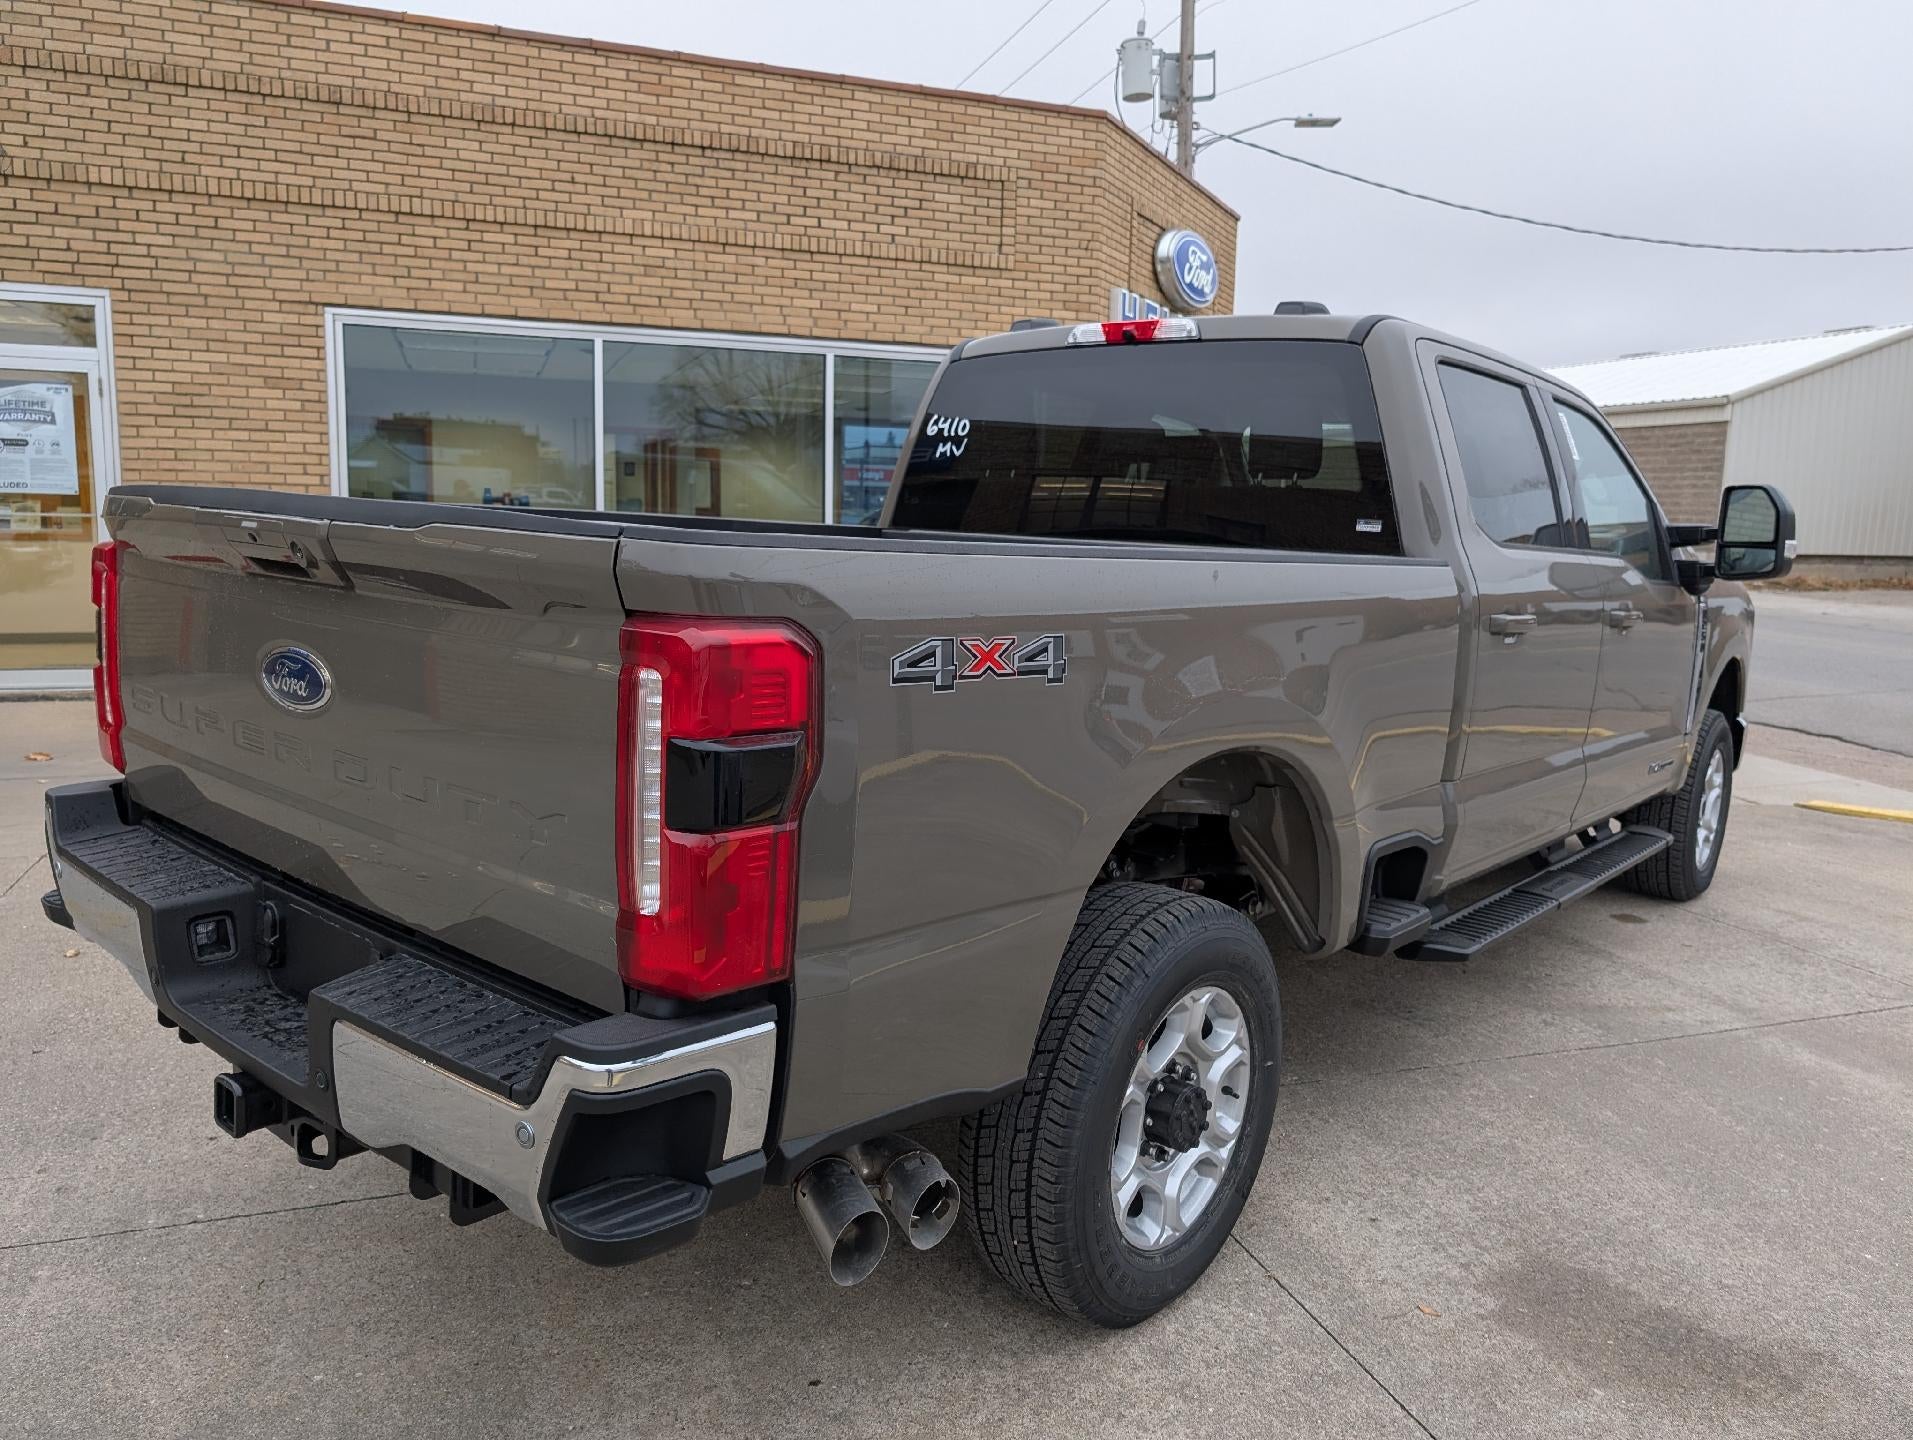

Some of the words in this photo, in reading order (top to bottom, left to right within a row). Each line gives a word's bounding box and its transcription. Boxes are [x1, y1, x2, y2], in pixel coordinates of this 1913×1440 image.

[1183, 245, 1214, 294] Ford
[926, 413, 970, 437] 6410
[271, 658, 310, 697] Ford
[131, 685, 312, 773] SUPER
[333, 748, 568, 847] DUTY
